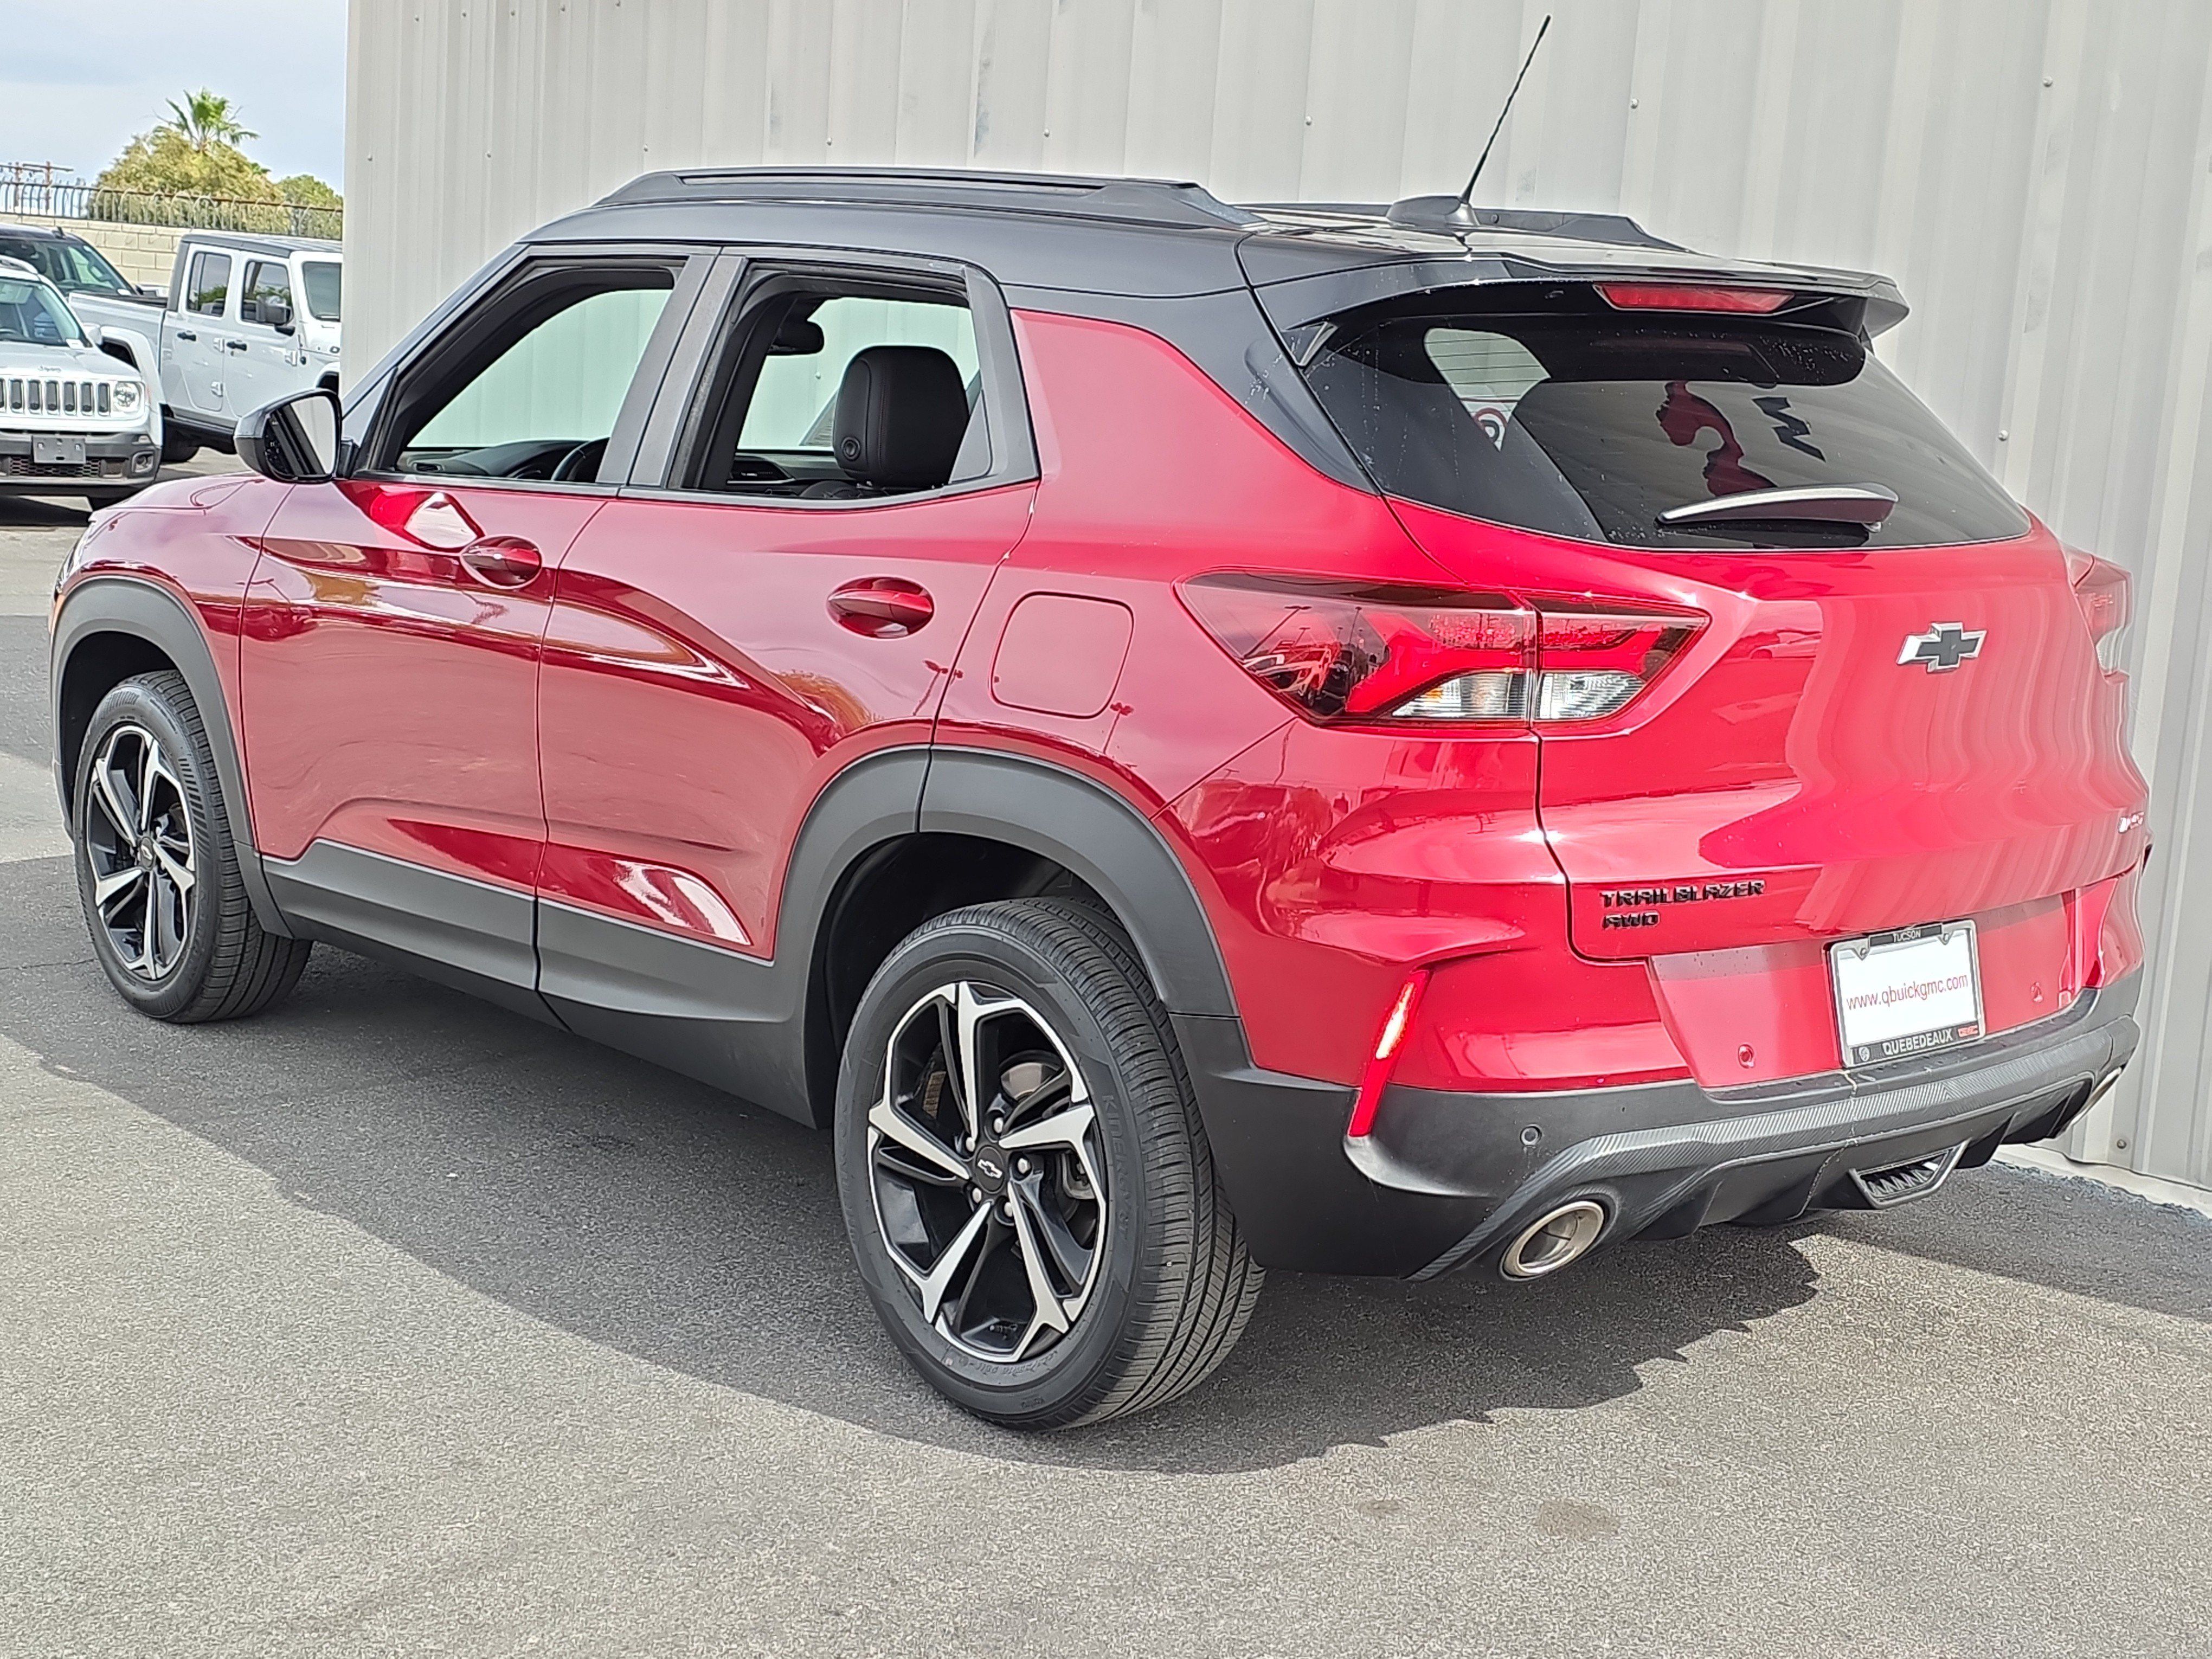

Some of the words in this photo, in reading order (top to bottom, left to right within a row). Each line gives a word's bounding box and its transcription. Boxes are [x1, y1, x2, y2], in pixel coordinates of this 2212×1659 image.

[1600, 880, 1765, 908] TRAILBLAZER
[1603, 912, 1659, 929] AWD
[1893, 929, 1921, 943] TUCSON
[1846, 975, 1968, 1010] www.qbuickgmc.com
[1882, 1028, 1953, 1056] QUEBEDEAUX
